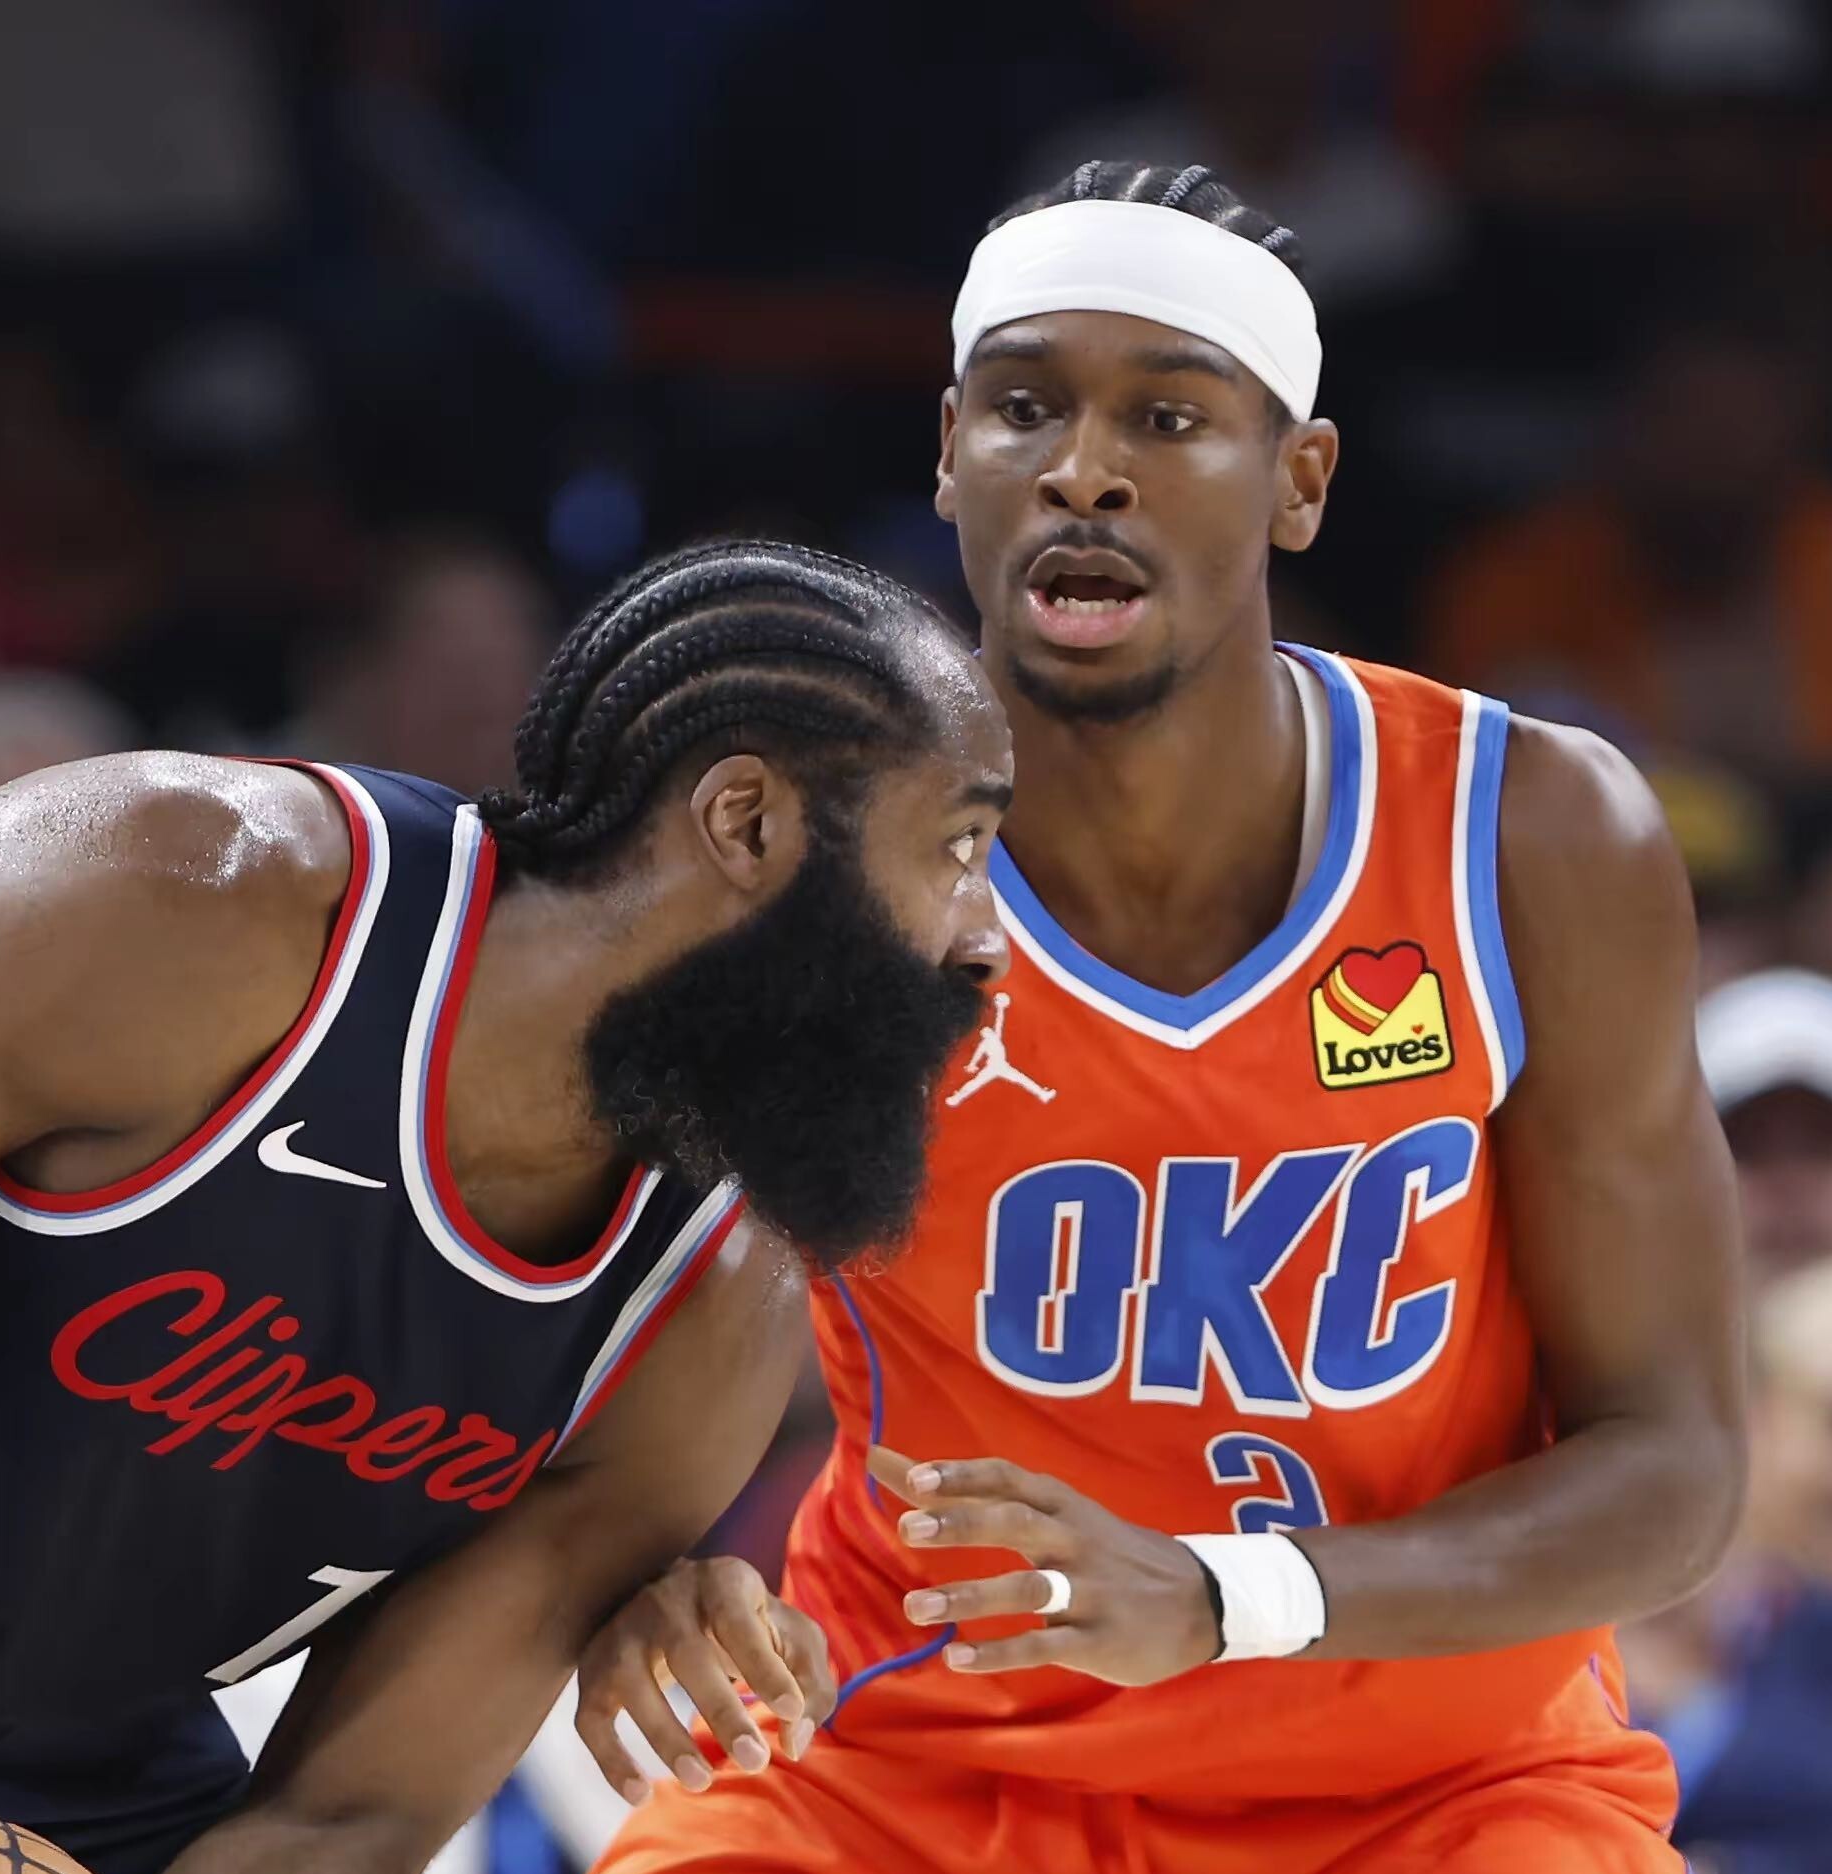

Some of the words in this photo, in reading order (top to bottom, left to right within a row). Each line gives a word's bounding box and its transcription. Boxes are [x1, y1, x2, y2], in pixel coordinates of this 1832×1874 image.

[976, 1116, 1480, 1417] OKC
[50, 1269, 559, 1511] Clippers
[1204, 1431, 1330, 1535] 2
[203, 1563, 395, 1685] 1
